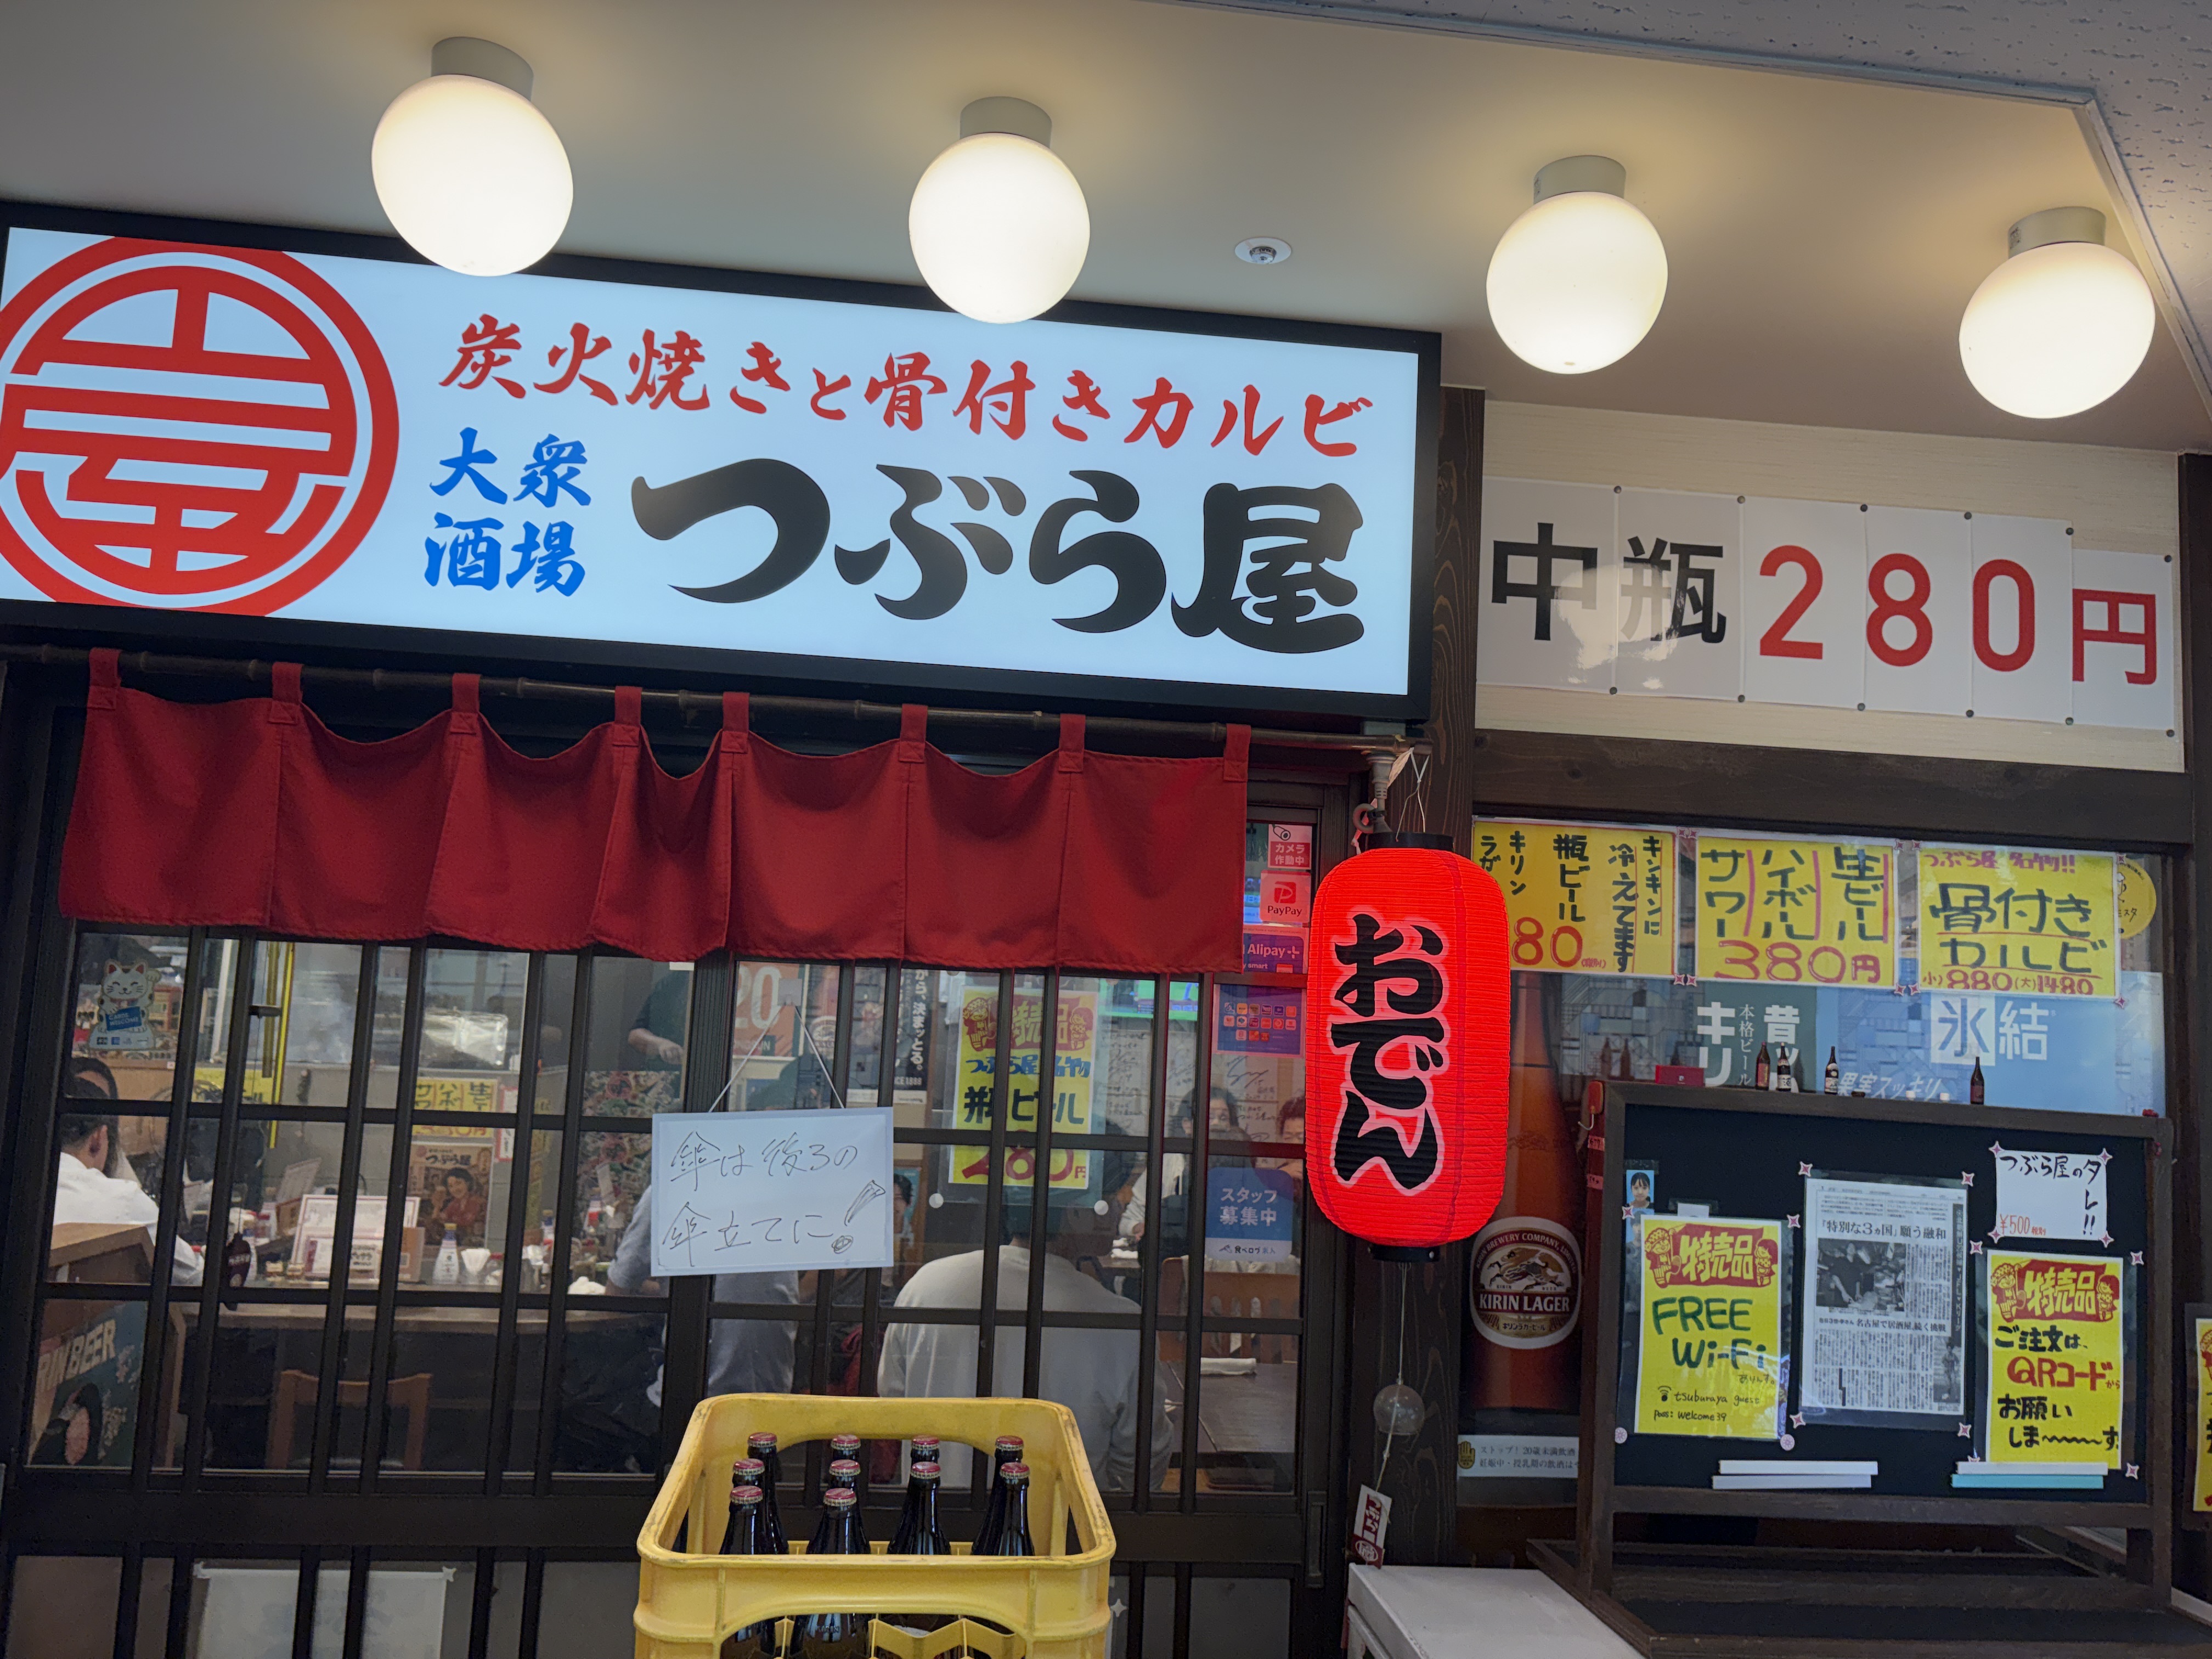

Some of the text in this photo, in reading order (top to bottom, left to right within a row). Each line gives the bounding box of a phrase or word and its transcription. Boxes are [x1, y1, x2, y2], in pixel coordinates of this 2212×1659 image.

[439, 314, 1373, 456] 炭火焼きと骨付きカルビ
[430, 427, 591, 508] 大衆
[425, 512, 585, 597] 酒場
[631, 458, 1364, 653] つぶら屋
[1491, 522, 2157, 685] 中瓶280円
[1275, 855, 1304, 866] 作動中
[1276, 844, 1305, 854] カメラ
[1509, 830, 1526, 896] キリン
[1553, 833, 1590, 922] 瓶ビール
[1643, 836, 1661, 936] キンキンに
[1700, 849, 1746, 938] サワー
[1761, 849, 1817, 941] ハイボール
[1831, 846, 1885, 941] 生ビール
[1267, 905, 1302, 917] PayPay
[1607, 843, 1639, 973] 冷えてます
[1928, 883, 2092, 938] 骨付き
[1714, 940, 1881, 984] 380円
[1939, 938, 2108, 973] カルビ
[1330, 913, 1444, 1190] おでん
[1738, 1003, 1755, 1086] 本格ビール
[1938, 998, 2050, 1060] 氷結
[670, 1130, 859, 1191] 傘は後ろの
[1220, 1187, 1278, 1204] スタッフ
[1220, 1206, 1277, 1227] 募集中
[1486, 1233, 1520, 1252] BREWERY
[1680, 1232, 1754, 1281] 特売品
[1479, 1293, 1570, 1312] KIRIN LAGER
[1651, 1296, 1754, 1335] FREE
[2025, 1267, 2096, 1317] 特売品
[1502, 1322, 1546, 1331] キリンラガービール
[1672, 1337, 1767, 1370] Wi-Fi
[1674, 1389, 1760, 1407] tsuburaya guest
[1997, 1393, 2073, 1421] お願い
